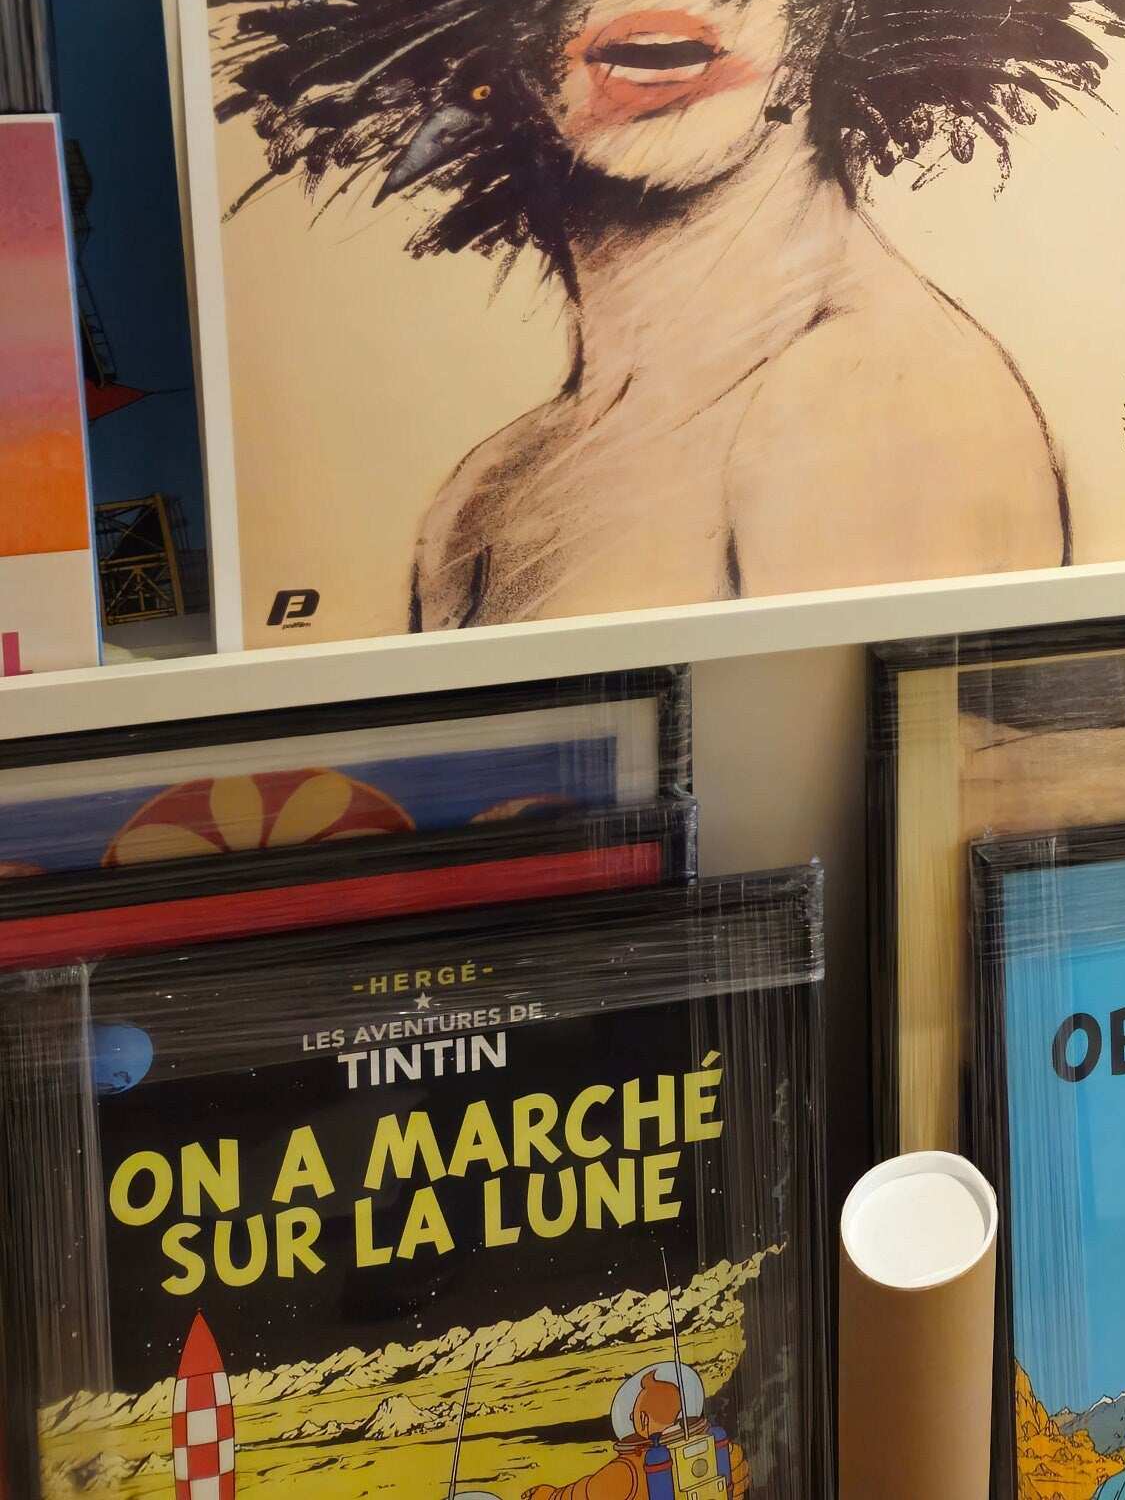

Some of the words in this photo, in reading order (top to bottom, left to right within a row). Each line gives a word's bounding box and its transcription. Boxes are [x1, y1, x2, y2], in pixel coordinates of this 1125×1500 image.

[302, 1028, 346, 1052] LES
[352, 1007, 500, 1045] AVENTURES
[509, 1002, 544, 1023] DE
[337, 1031, 507, 1089] TINTIN
[109, 1138, 241, 1227] ON
[271, 1125, 336, 1204] A
[363, 1050, 724, 1191] MARCHÉ
[160, 1205, 325, 1296] SUR
[354, 1185, 455, 1268] LA
[484, 1150, 682, 1250] LUNE
